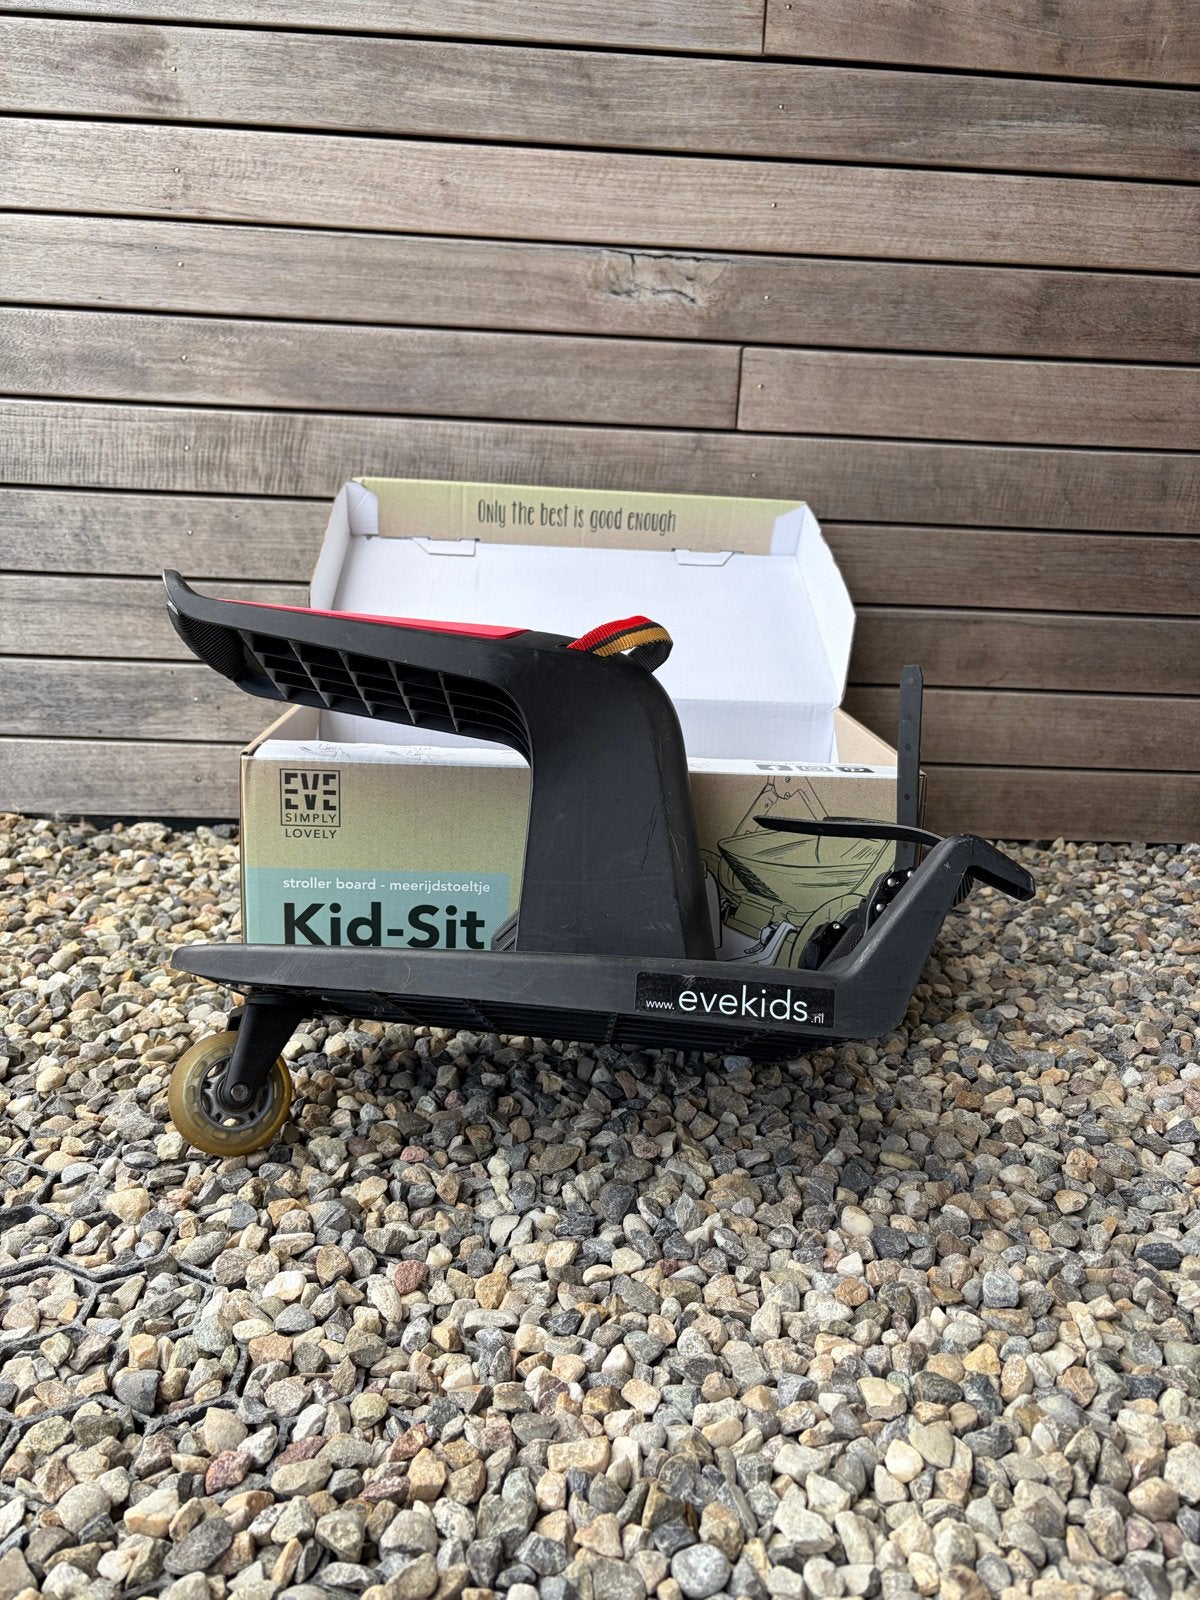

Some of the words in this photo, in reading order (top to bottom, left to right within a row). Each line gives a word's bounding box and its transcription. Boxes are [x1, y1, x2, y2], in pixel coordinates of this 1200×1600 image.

[478, 499, 506, 528] Only
[512, 501, 535, 526] the
[540, 502, 569, 527] best
[573, 505, 584, 528] is
[590, 507, 622, 533] good
[627, 509, 677, 536] enough
[284, 773, 337, 811] EVE
[285, 813, 337, 823] SIMPLY
[285, 828, 337, 839] LOVELY
[283, 877, 332, 890] stroller
[336, 878, 376, 890] board
[389, 880, 491, 896] meerijdstoeltje
[283, 901, 486, 950] Kid-Sit
[645, 984, 825, 1025] www.evekids.nl
